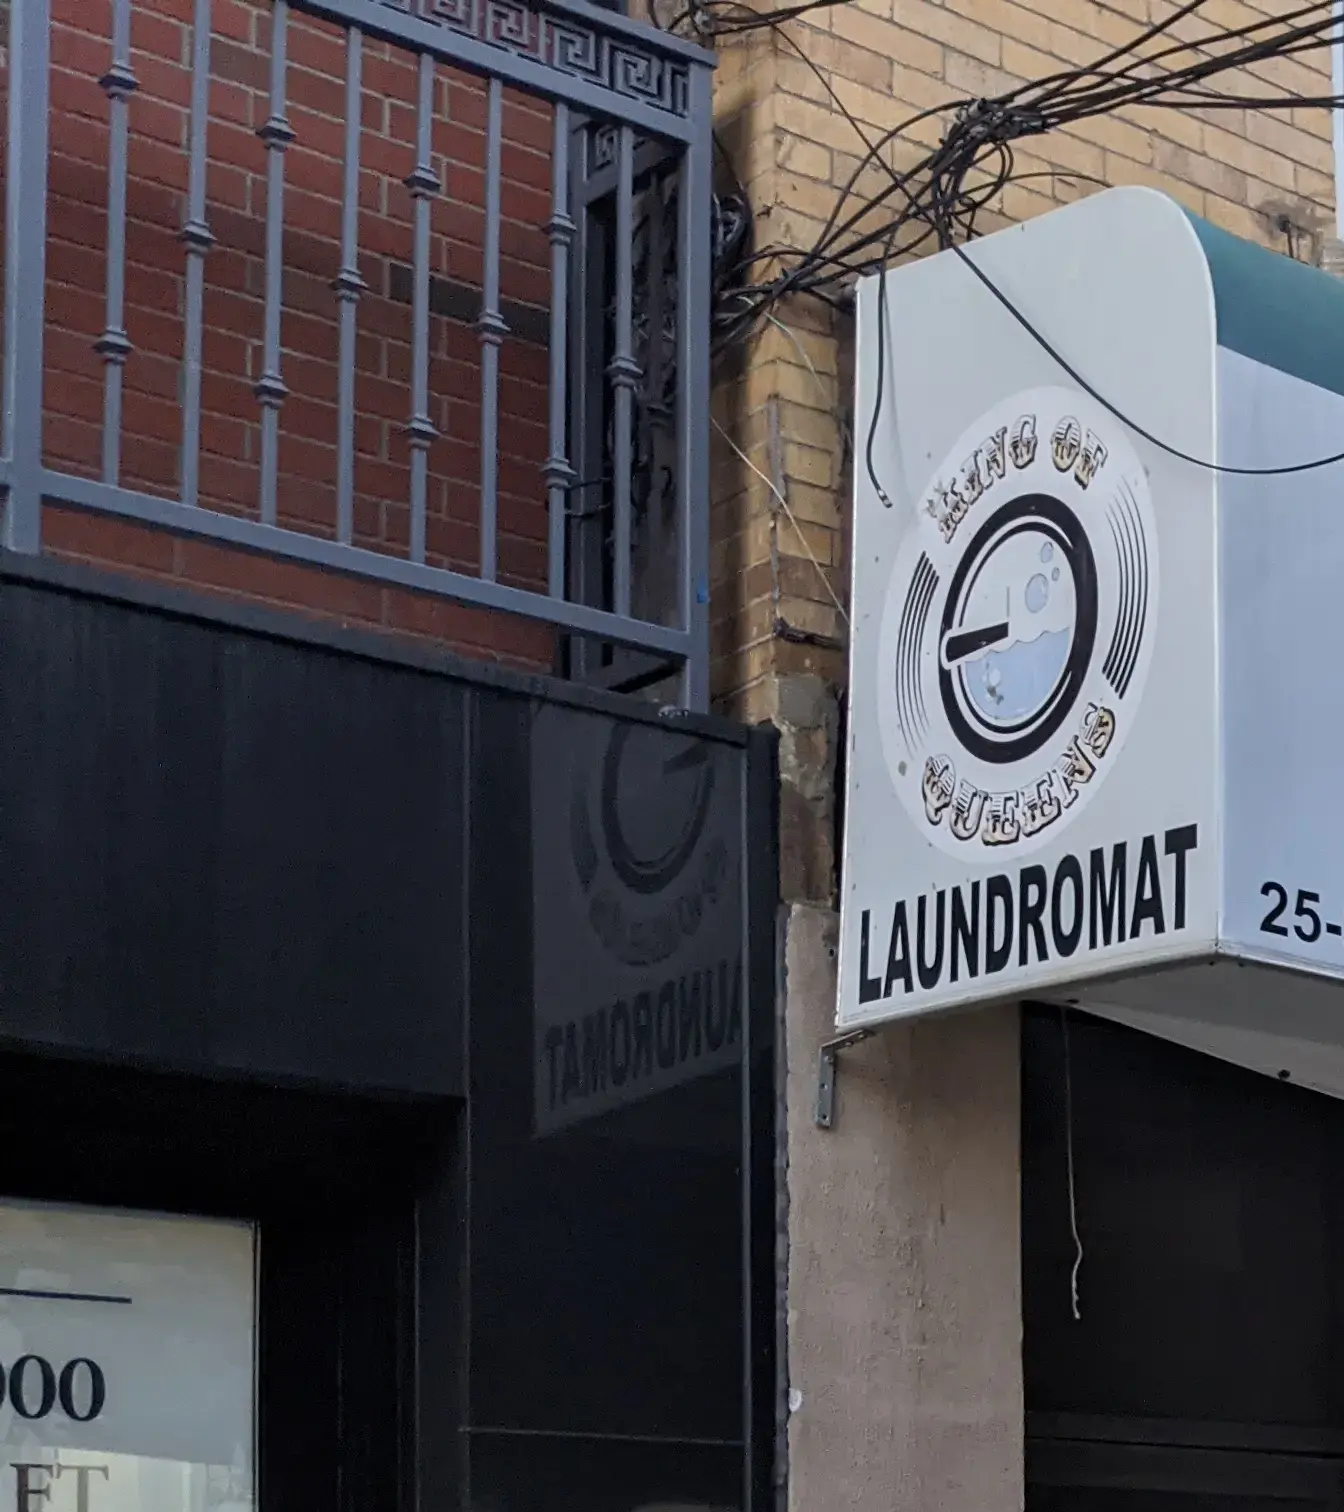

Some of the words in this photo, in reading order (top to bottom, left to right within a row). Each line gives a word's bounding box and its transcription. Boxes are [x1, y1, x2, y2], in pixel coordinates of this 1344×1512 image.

[936, 414, 1038, 544] KING
[1049, 413, 1108, 490] OF
[920, 701, 1117, 847] QUEENS
[858, 823, 1198, 1004] LAUNDROMAT
[0, 1354, 106, 1422] 00
